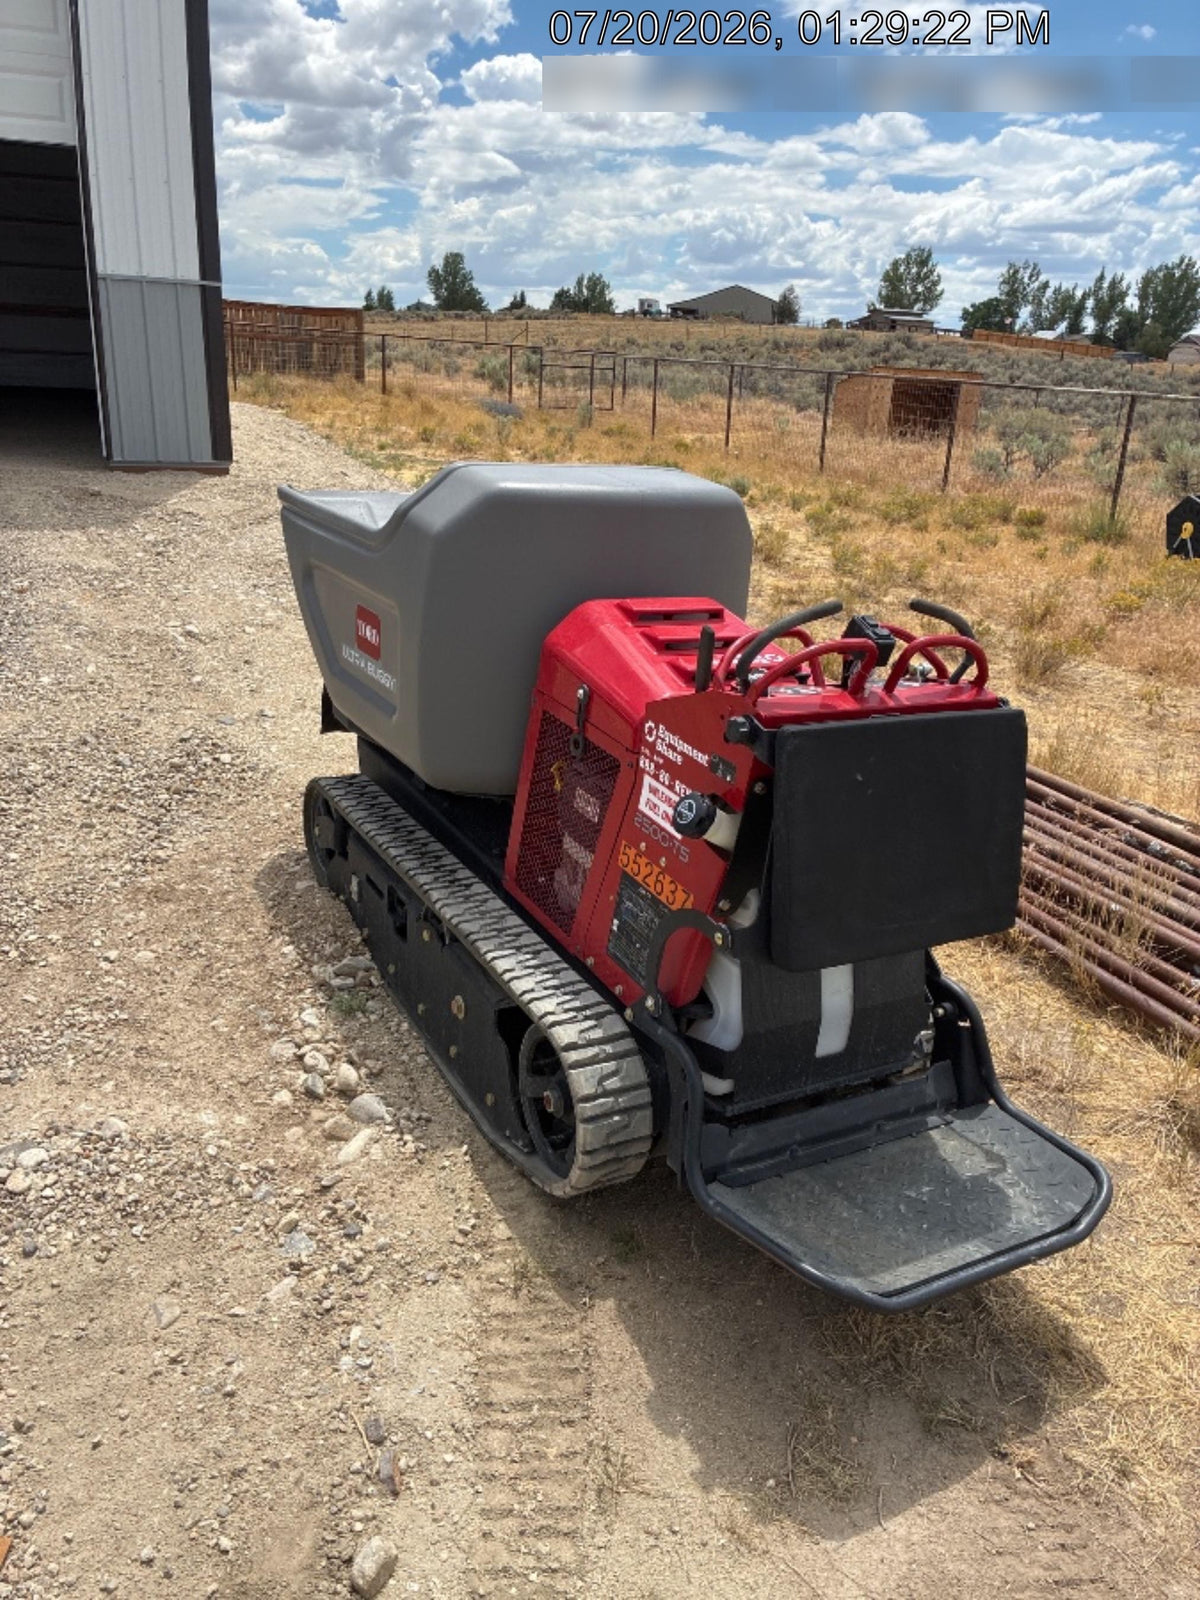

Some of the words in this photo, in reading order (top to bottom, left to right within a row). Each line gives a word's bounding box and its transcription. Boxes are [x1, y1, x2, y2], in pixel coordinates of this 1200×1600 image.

[656, 739, 683, 765] Share
[658, 723, 709, 767] Equipment
[620, 844, 691, 909] 552637
